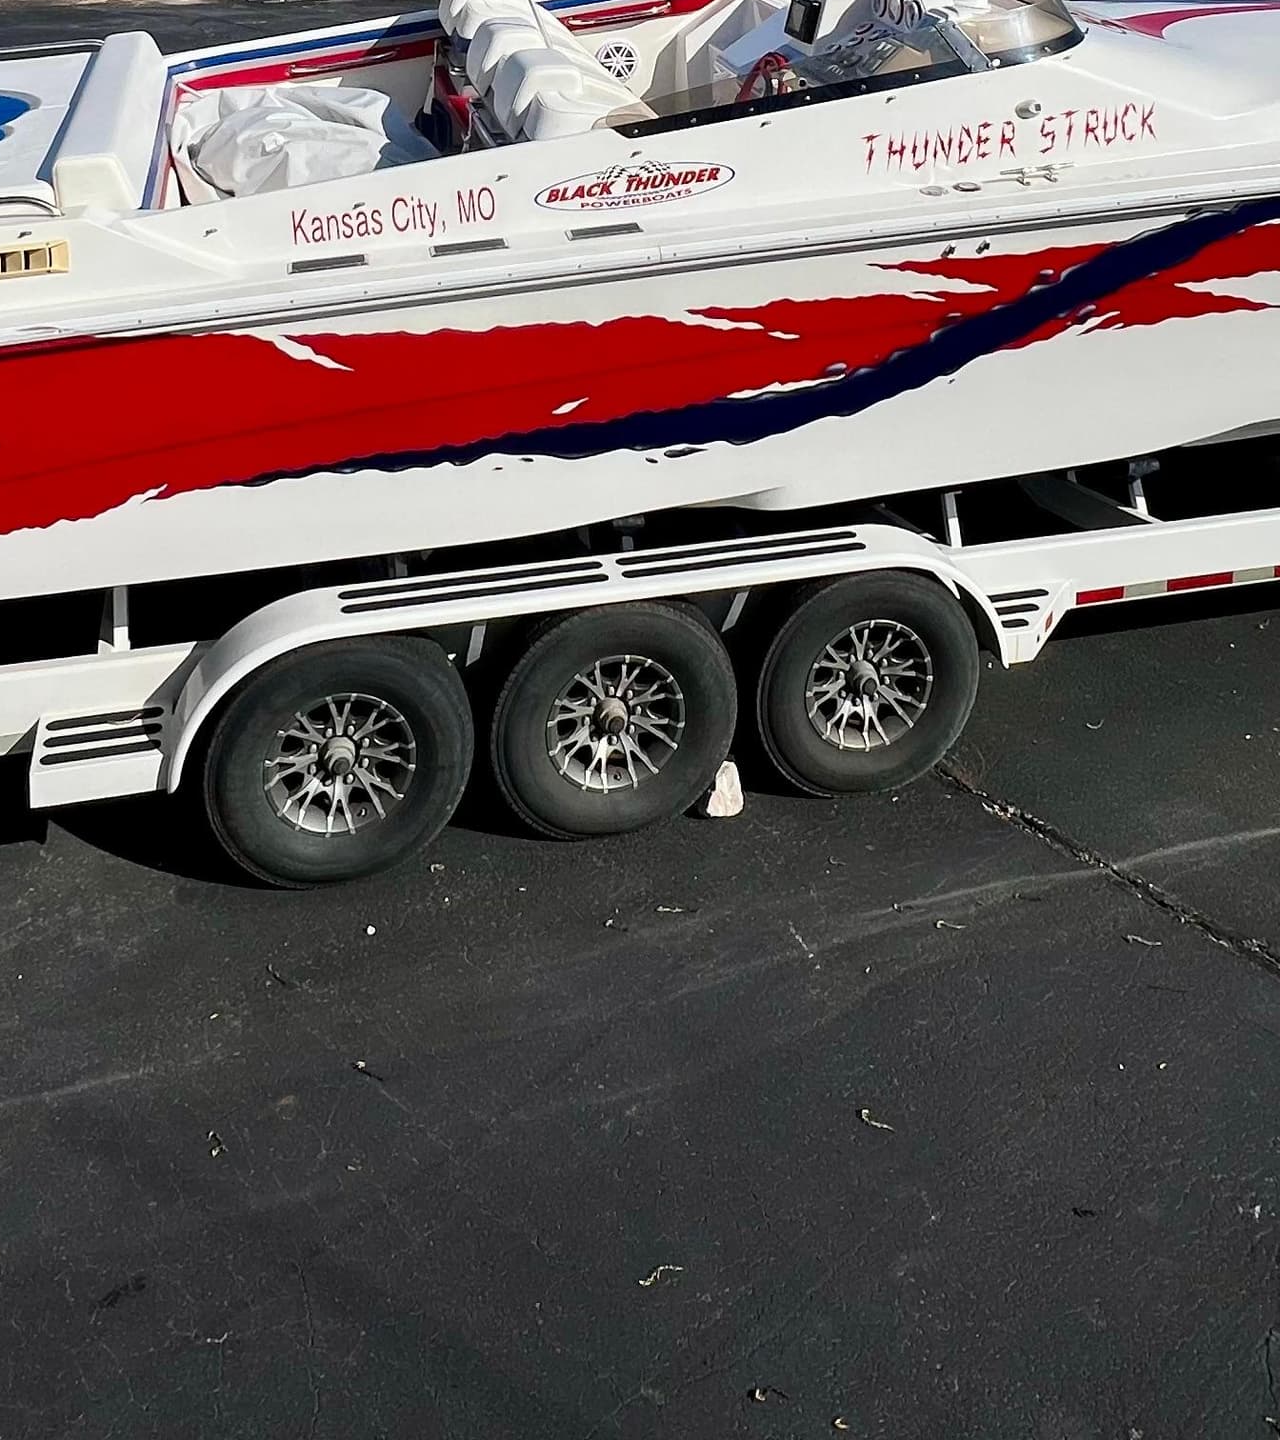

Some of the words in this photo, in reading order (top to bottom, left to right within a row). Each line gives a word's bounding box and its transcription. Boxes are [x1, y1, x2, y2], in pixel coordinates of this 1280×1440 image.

[861, 119, 1017, 175] THUNDER
[1039, 101, 1158, 153] STRUCK
[545, 179, 616, 204] BLACK
[625, 166, 721, 193] THUNDER
[580, 188, 693, 209] POWERBOATS
[291, 208, 384, 245] Kansas
[391, 196, 447, 238] City,
[457, 186, 496, 225] MO
